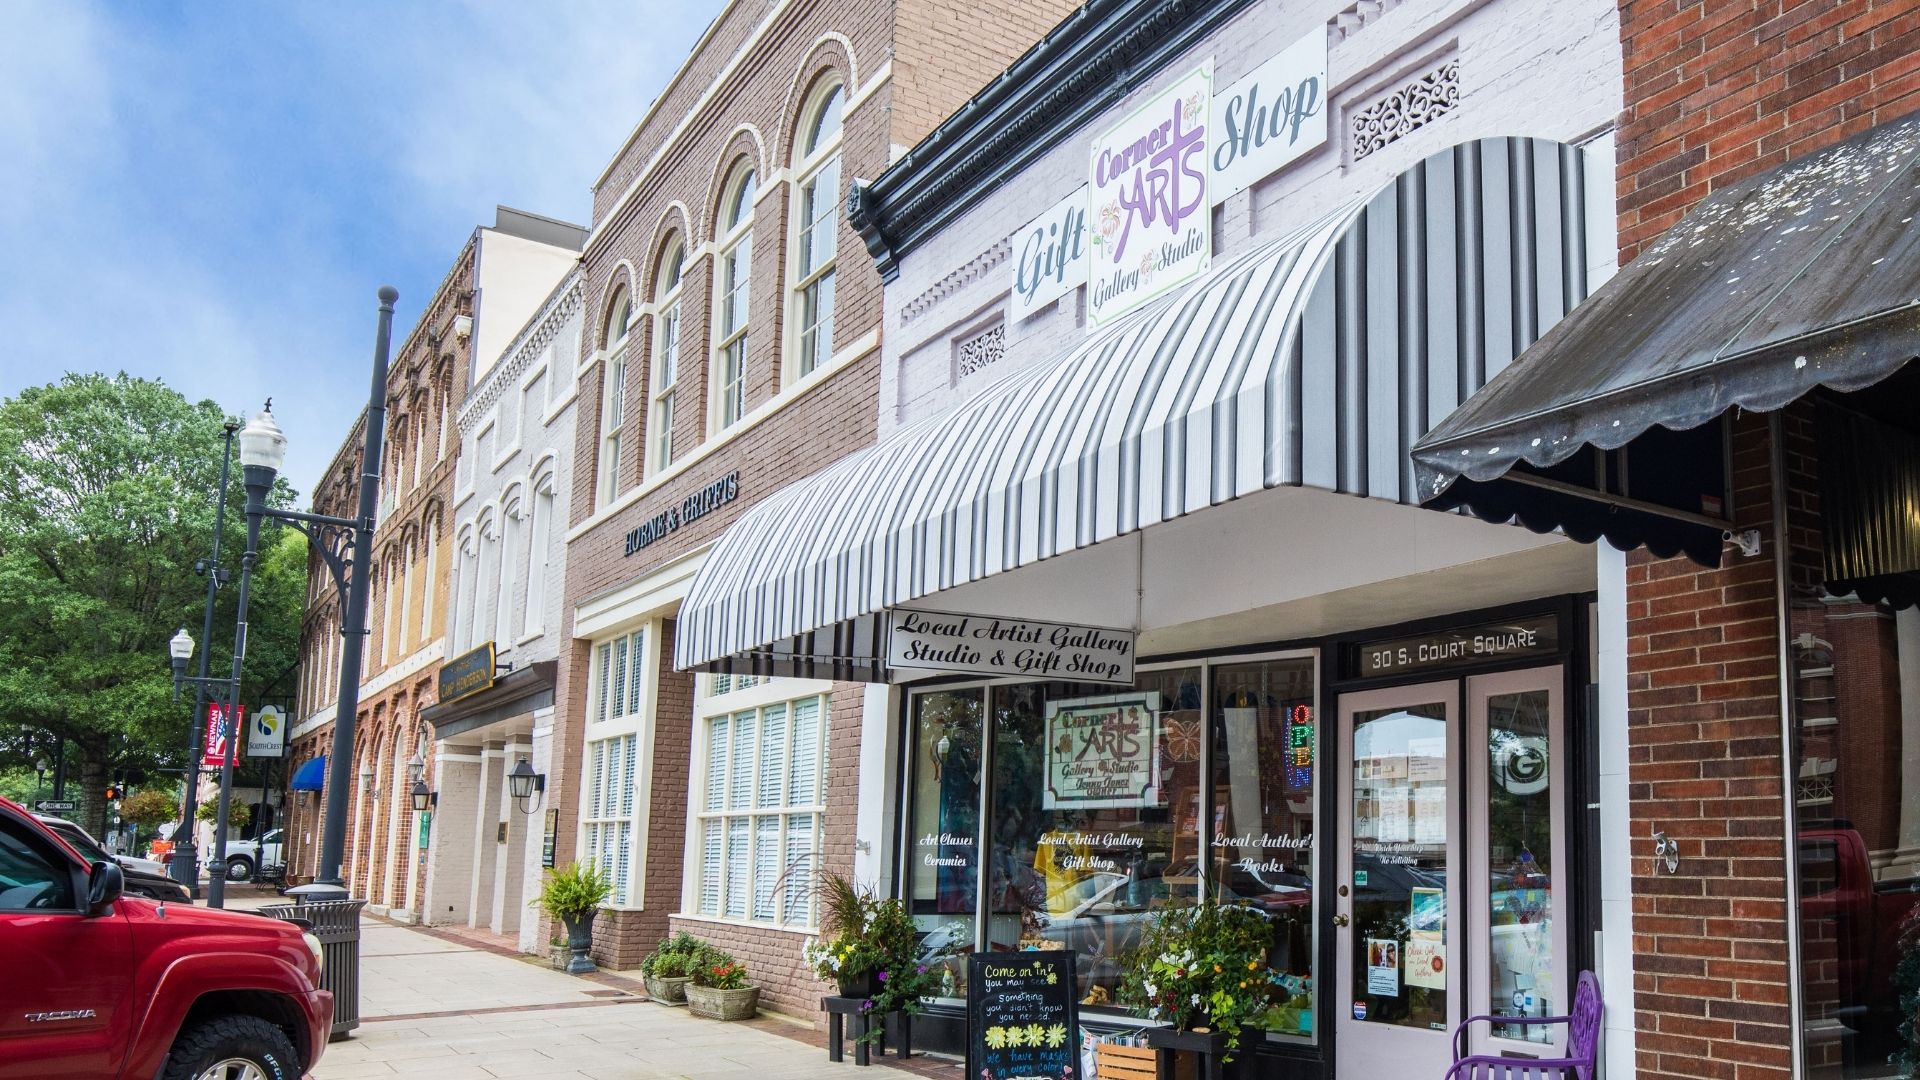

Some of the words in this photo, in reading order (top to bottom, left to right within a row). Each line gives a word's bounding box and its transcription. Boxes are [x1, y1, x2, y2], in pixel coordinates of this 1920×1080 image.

[1213, 76, 1323, 172] Shop
[1096, 118, 1172, 188] Corner
[1114, 99, 1205, 263] ARTS
[1014, 205, 1086, 306] Gift
[1093, 269, 1140, 308] Gallery
[1157, 228, 1203, 271] Studio
[624, 511, 668, 557] HORNE
[667, 506, 680, 533] &
[680, 470, 740, 526] GRIFFIS
[896, 612, 968, 637] Local
[973, 619, 1043, 644] Artist
[1050, 627, 1130, 655] Gallery
[1372, 651, 1391, 669] 30
[1398, 648, 1412, 665] S.
[1419, 641, 1467, 662] COURT
[1473, 630, 1537, 655] SQUARE
[904, 639, 981, 665] Studio
[990, 650, 1005, 666] &
[1012, 649, 1061, 674] Gift
[1066, 653, 1121, 679] Shop
[1062, 711, 1118, 729] Corner
[208, 709, 218, 747] NEWNAN
[1075, 707, 1140, 761] ARTS
[249, 742, 283, 750] SOUTHCREST
[1294, 704, 1311, 787] OPEN
[1062, 762, 1095, 780] Gallery
[1109, 760, 1139, 774] Studio
[60, 801, 73, 809] WAY
[919, 833, 938, 845] Art
[939, 833, 973, 846] Classes
[1037, 833, 1067, 846] Local
[1068, 833, 1101, 846] Artist
[1103, 833, 1144, 849] Gallery
[1211, 833, 1251, 848] Local
[924, 854, 968, 867] Ceramics
[1063, 856, 1086, 870] Gift
[1087, 856, 1115, 870] Shop
[1240, 858, 1286, 873] Books
[985, 965, 1017, 978] Come
[1020, 968, 1032, 977] on
[985, 979, 1003, 992] you
[1006, 979, 1025, 990] may
[1031, 978, 1047, 986] see
[998, 991, 1044, 1005] something
[25, 1009, 97, 1022] TACOMA
[986, 1005, 1002, 1017] you
[1010, 1002, 1033, 1012] didn't
[1039, 1003, 1063, 1012] know
[999, 1014, 1014, 1024] you
[1008, 1048, 1034, 1062] have
[1040, 1050, 1069, 1062] masks
[1011, 1065, 1033, 1076] every
